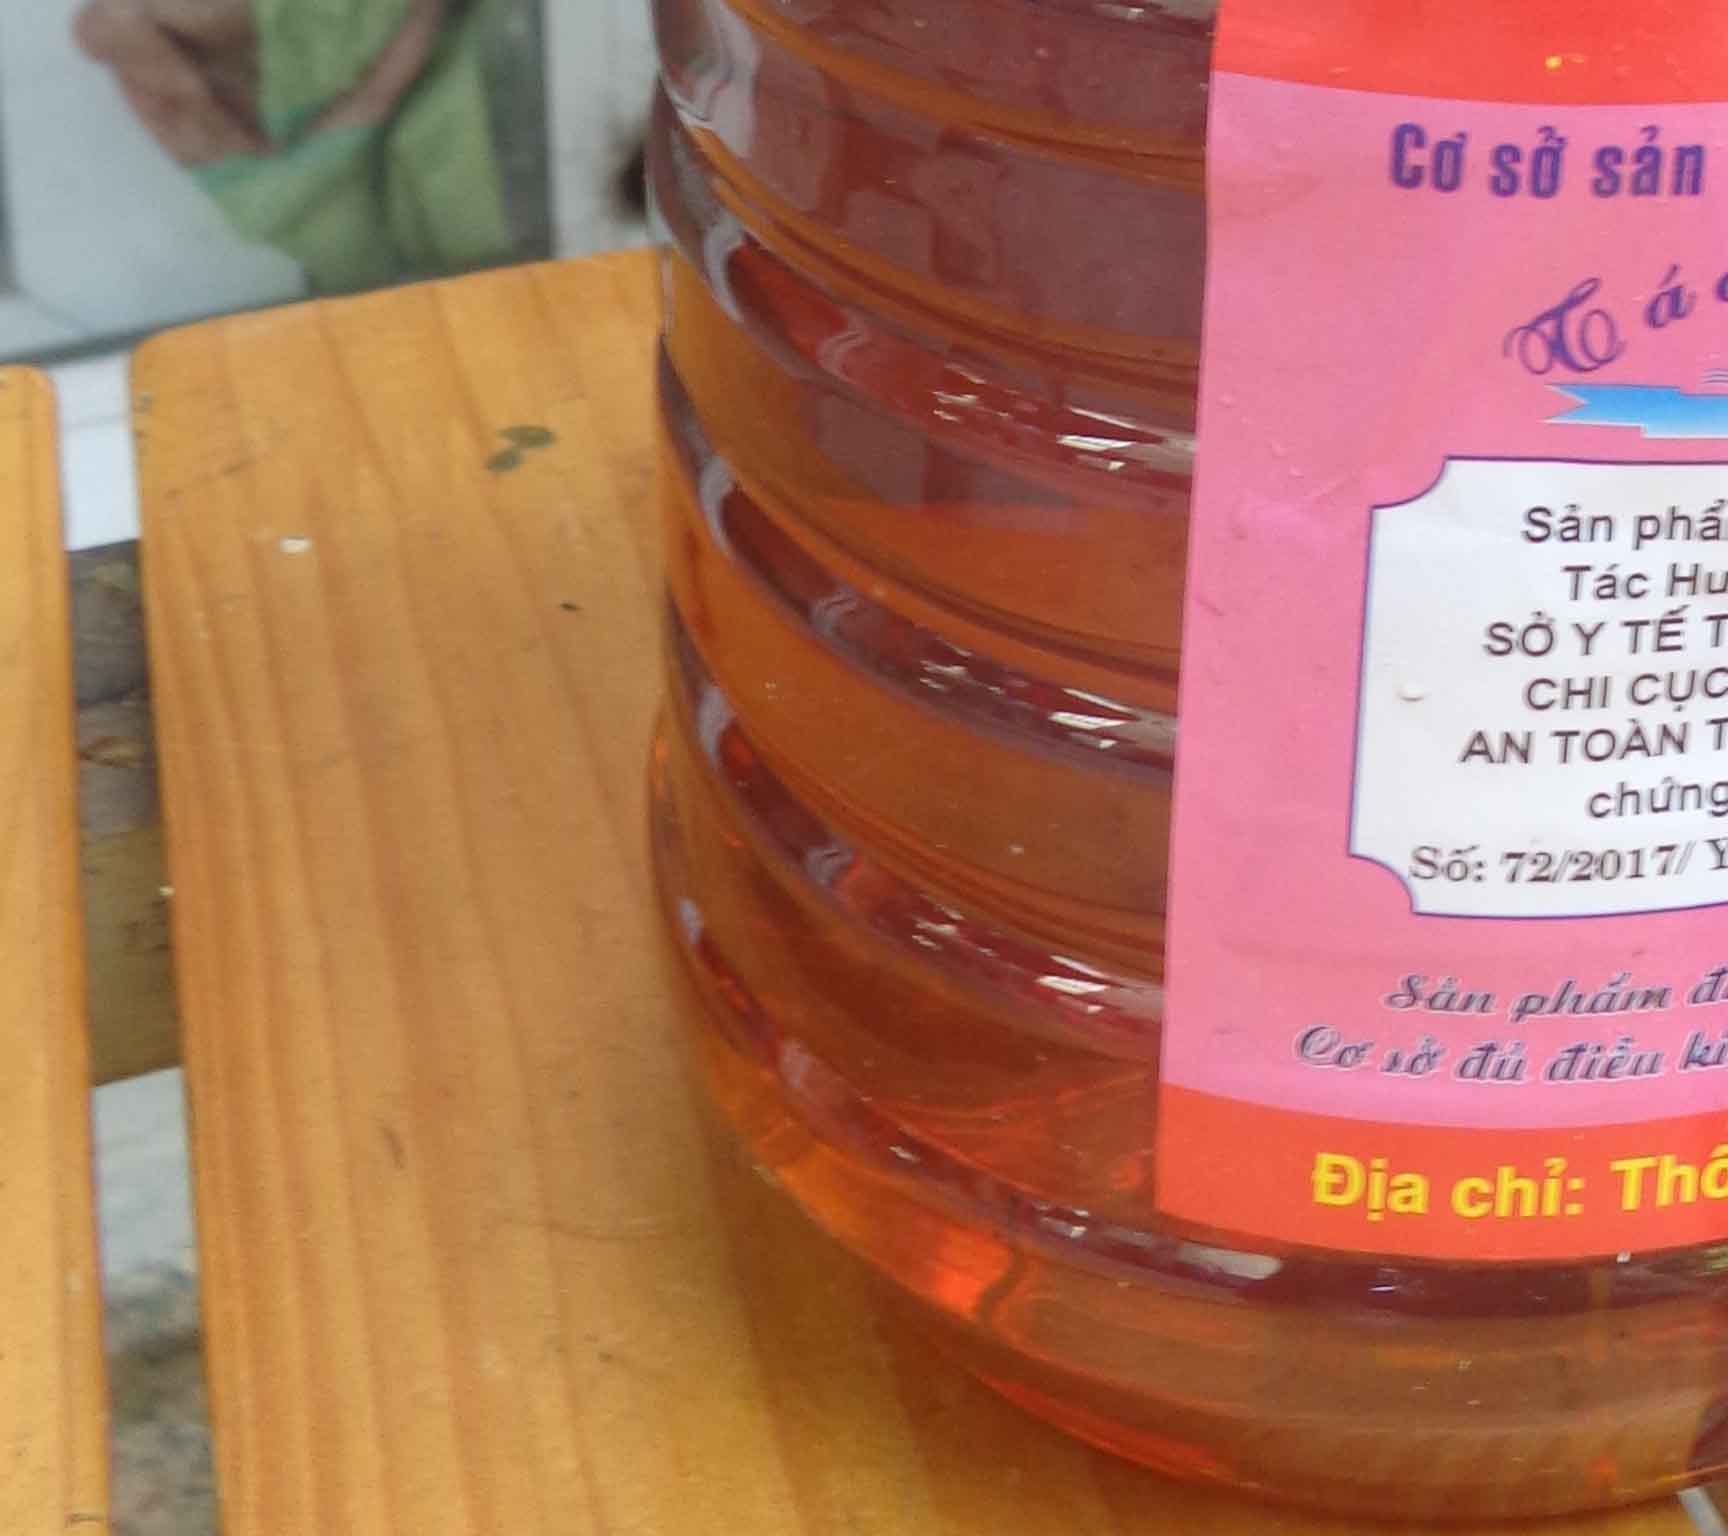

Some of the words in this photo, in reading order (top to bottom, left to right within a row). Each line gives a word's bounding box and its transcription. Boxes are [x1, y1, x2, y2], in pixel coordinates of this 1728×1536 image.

[1389, 122, 1468, 193] Cơ
[1489, 126, 1569, 199] sở
[1592, 125, 1707, 199] sản
[1521, 503, 1613, 544] Sản
[1563, 564, 1649, 602] Tác
[1482, 611, 1556, 658] SỞ
[1572, 621, 1608, 656] Y
[1622, 605, 1690, 654] TẾ
[1525, 675, 1611, 712] CHI
[1459, 730, 1533, 765] AN
[1550, 718, 1690, 764] TOÀN
[1409, 842, 1485, 883] Số:
[1501, 841, 1696, 884] 72/2017/
[1384, 972, 1498, 1016] Sản
[1311, 1151, 1430, 1222] Địa
[1451, 1156, 1584, 1218] chỉ:
